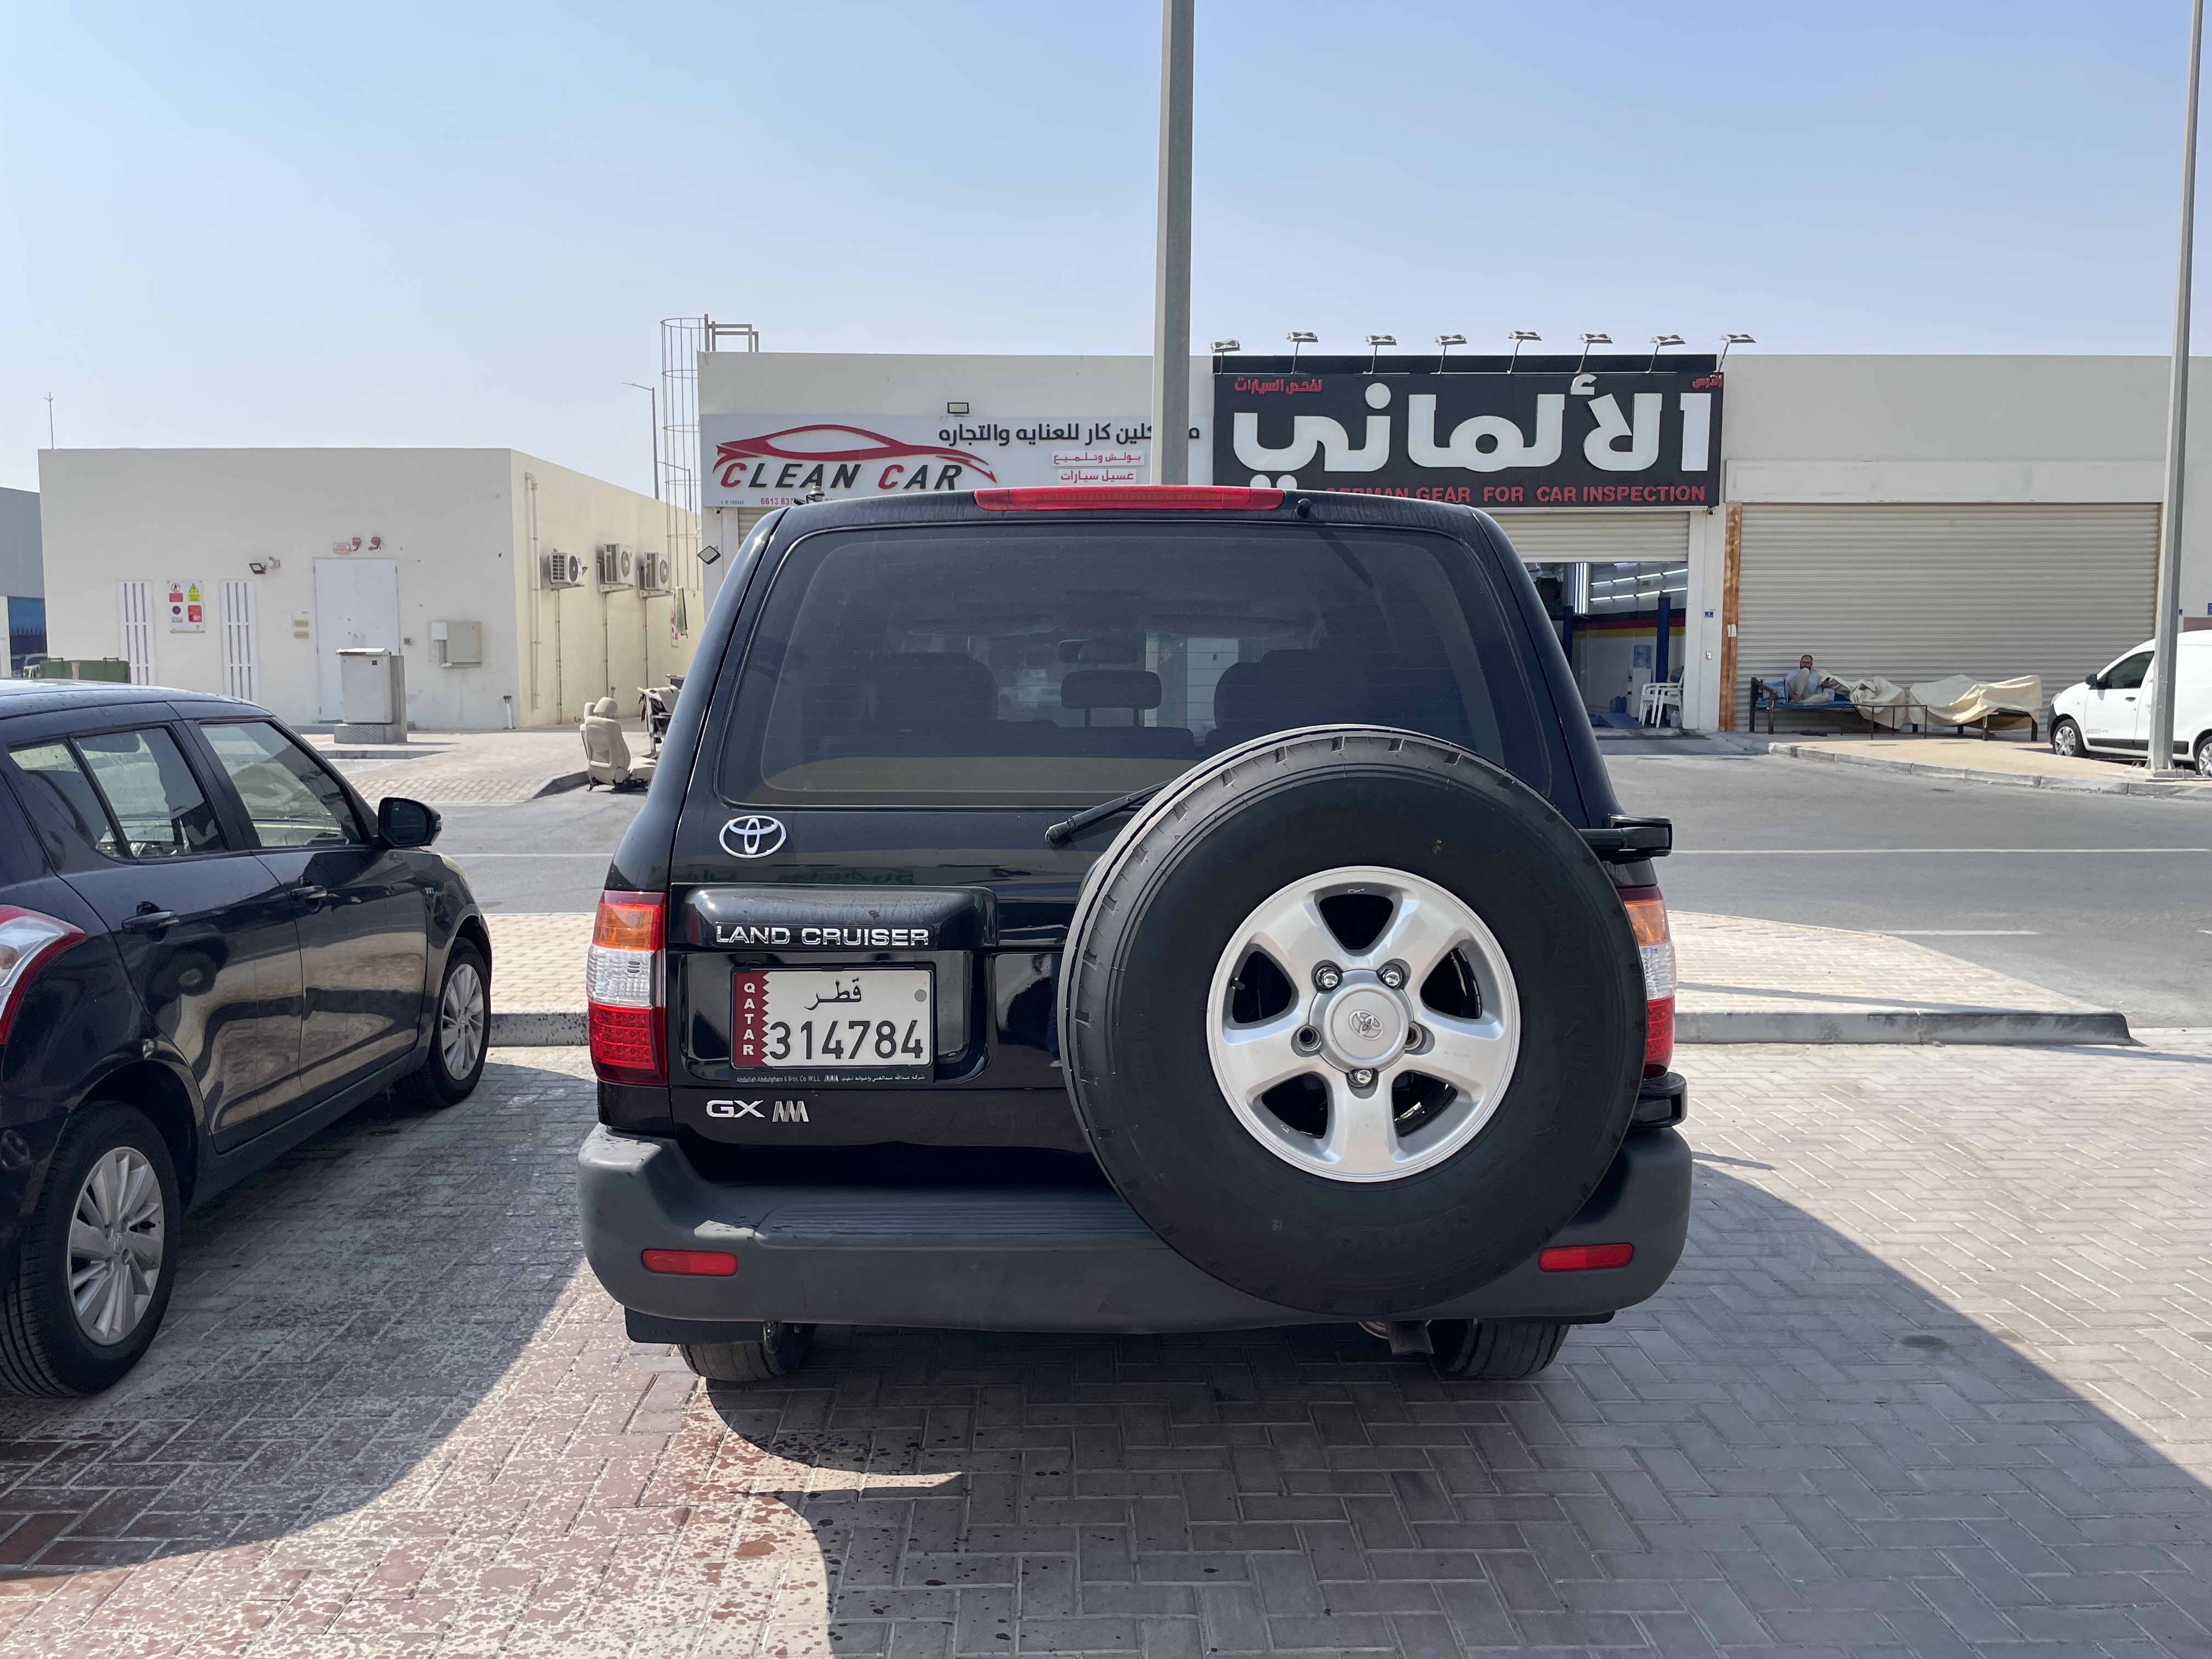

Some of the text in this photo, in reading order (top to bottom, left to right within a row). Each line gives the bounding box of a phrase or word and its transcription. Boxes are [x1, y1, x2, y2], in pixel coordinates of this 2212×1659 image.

[1234, 377, 1323, 395] لفحص السيارات
[939, 424, 1010, 446] والتجاره
[1016, 423, 1079, 446] للعنايه
[1085, 422, 1111, 445] كار
[1233, 375, 1712, 489] الألماني
[720, 462, 962, 490] CLEAN CAR
[1060, 470, 1134, 483] غسيل سيارات
[1325, 486, 1706, 503] MAN GEAR FOR CAR INSPECTION
[715, 925, 930, 946] LAND CRUISER
[804, 977, 862, 1011] قطر
[742, 983, 756, 1056] QATAR
[769, 1019, 924, 1060] 314784
[706, 1099, 765, 1118] GX
